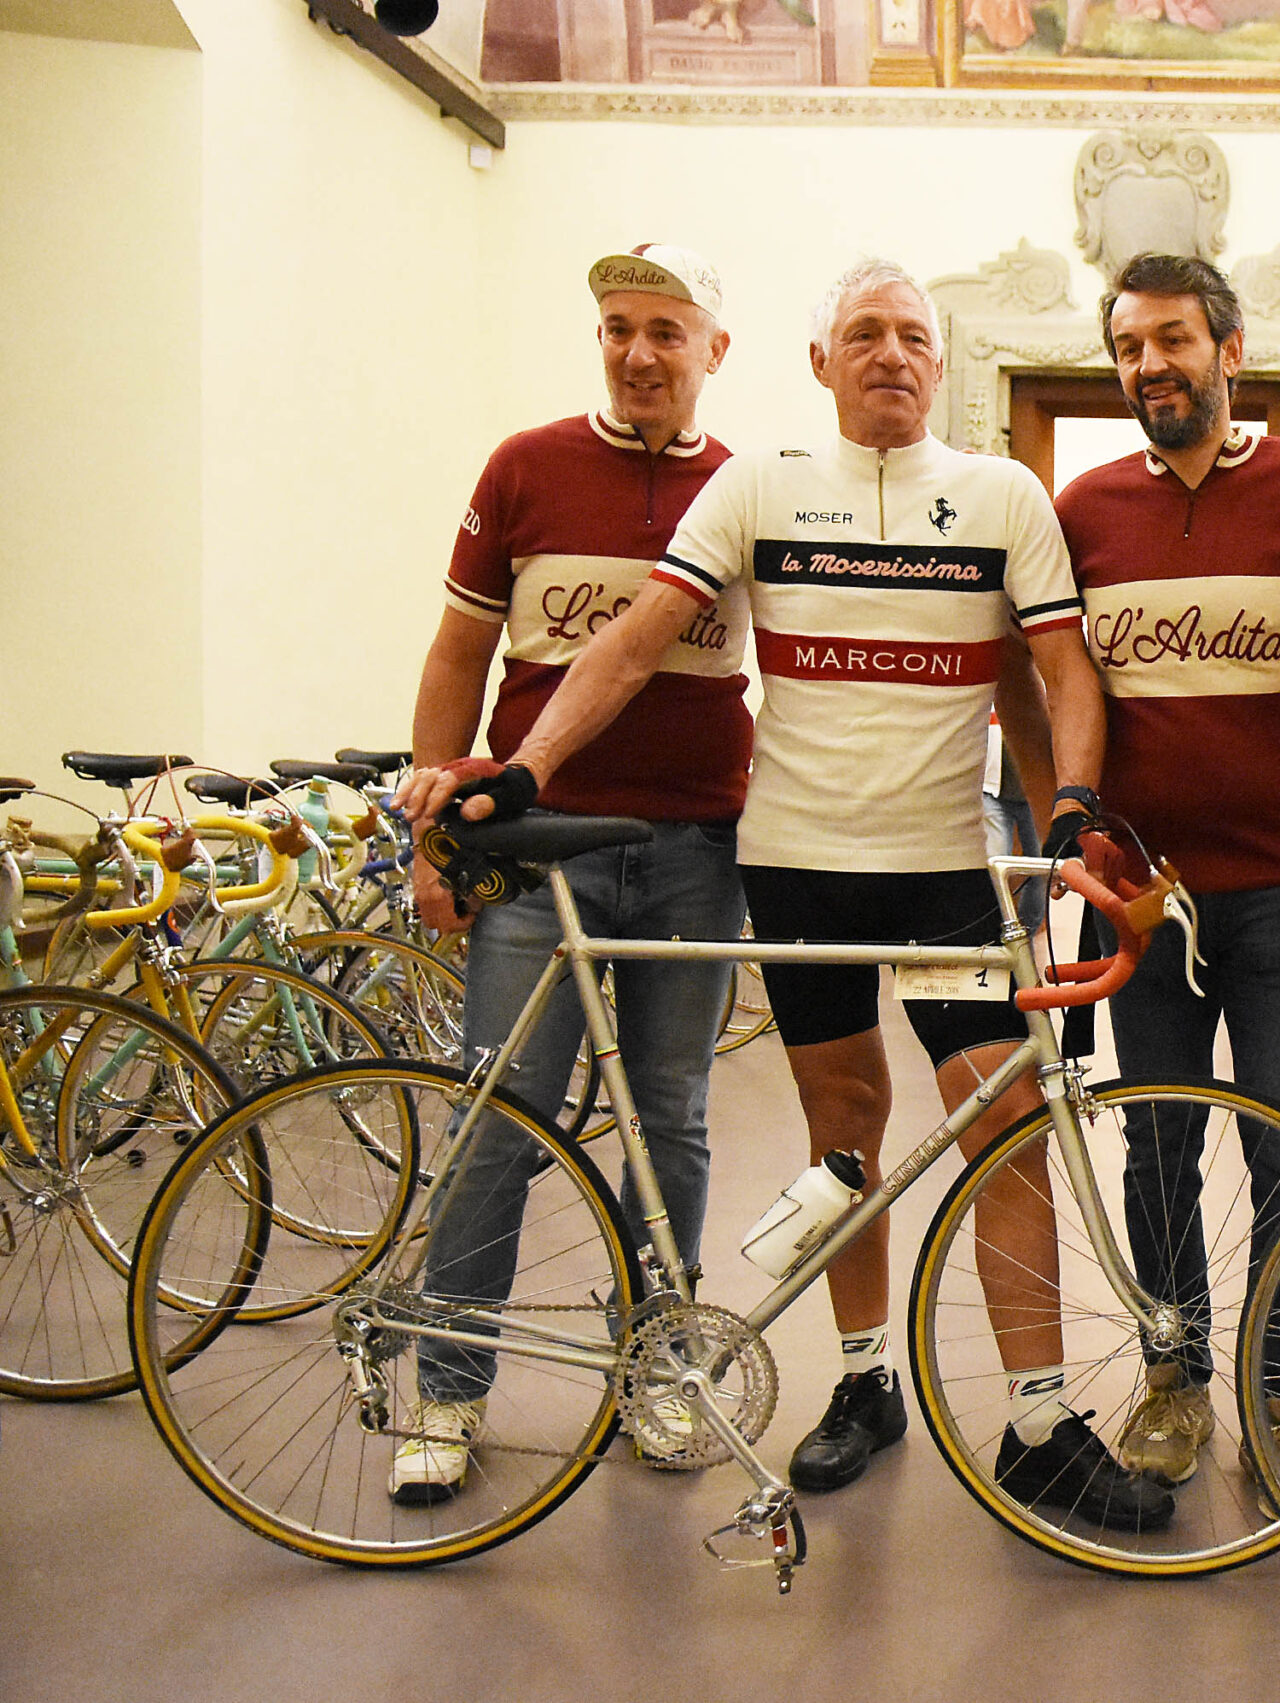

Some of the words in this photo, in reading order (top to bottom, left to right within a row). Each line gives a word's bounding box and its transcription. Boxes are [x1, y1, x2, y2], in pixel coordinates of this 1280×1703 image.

[596, 264, 667, 285] L'Ardita
[794, 511, 854, 525] MOSER
[779, 551, 804, 573] la
[809, 552, 983, 582] Moserissima
[794, 645, 962, 676] MARCONI
[974, 967, 989, 988] 1
[881, 1122, 953, 1194] CINELLI
